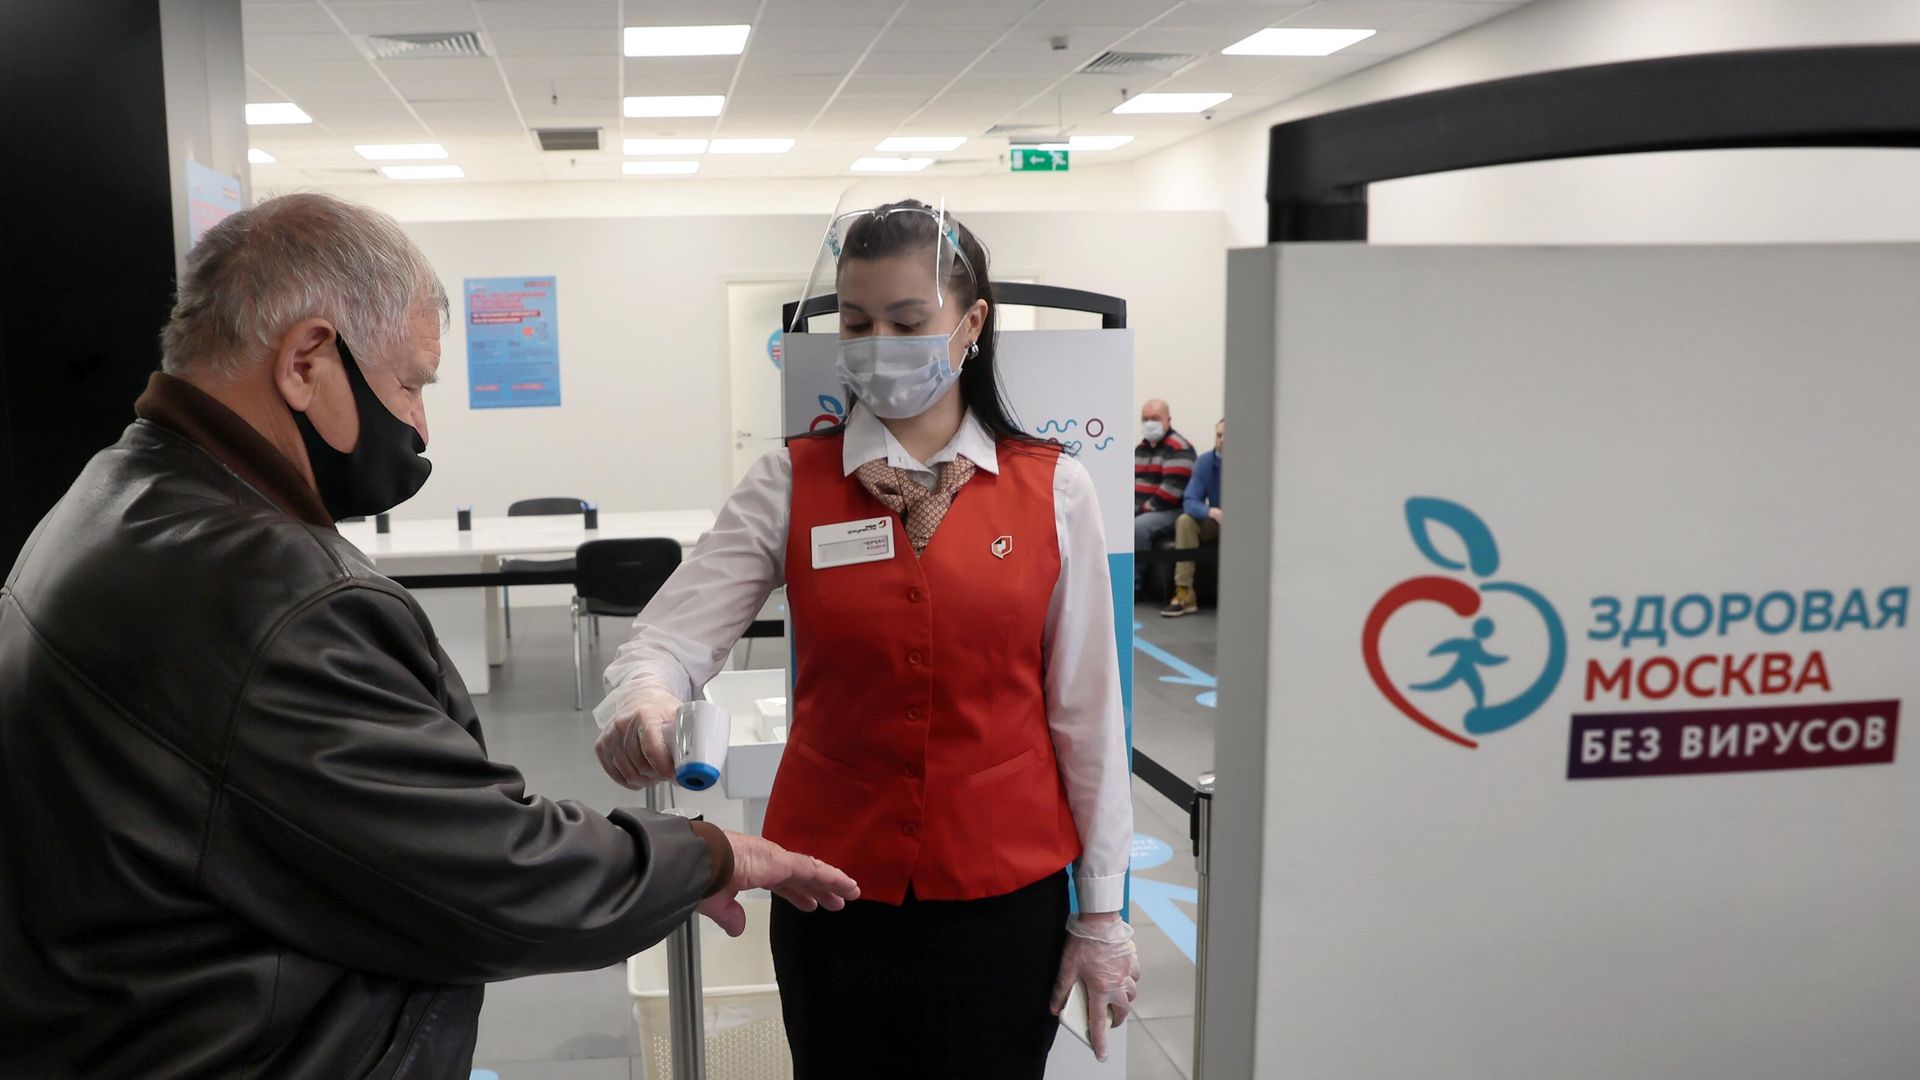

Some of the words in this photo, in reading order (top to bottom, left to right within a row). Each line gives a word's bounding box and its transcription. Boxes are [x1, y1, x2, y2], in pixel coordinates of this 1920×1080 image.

[1587, 586, 1911, 648] ЗДОРОВАЯ
[1584, 650, 1831, 701] МОСКВА
[1581, 729, 1661, 763] БЕЗ
[1680, 716, 1887, 760] ВИРУСОВ
